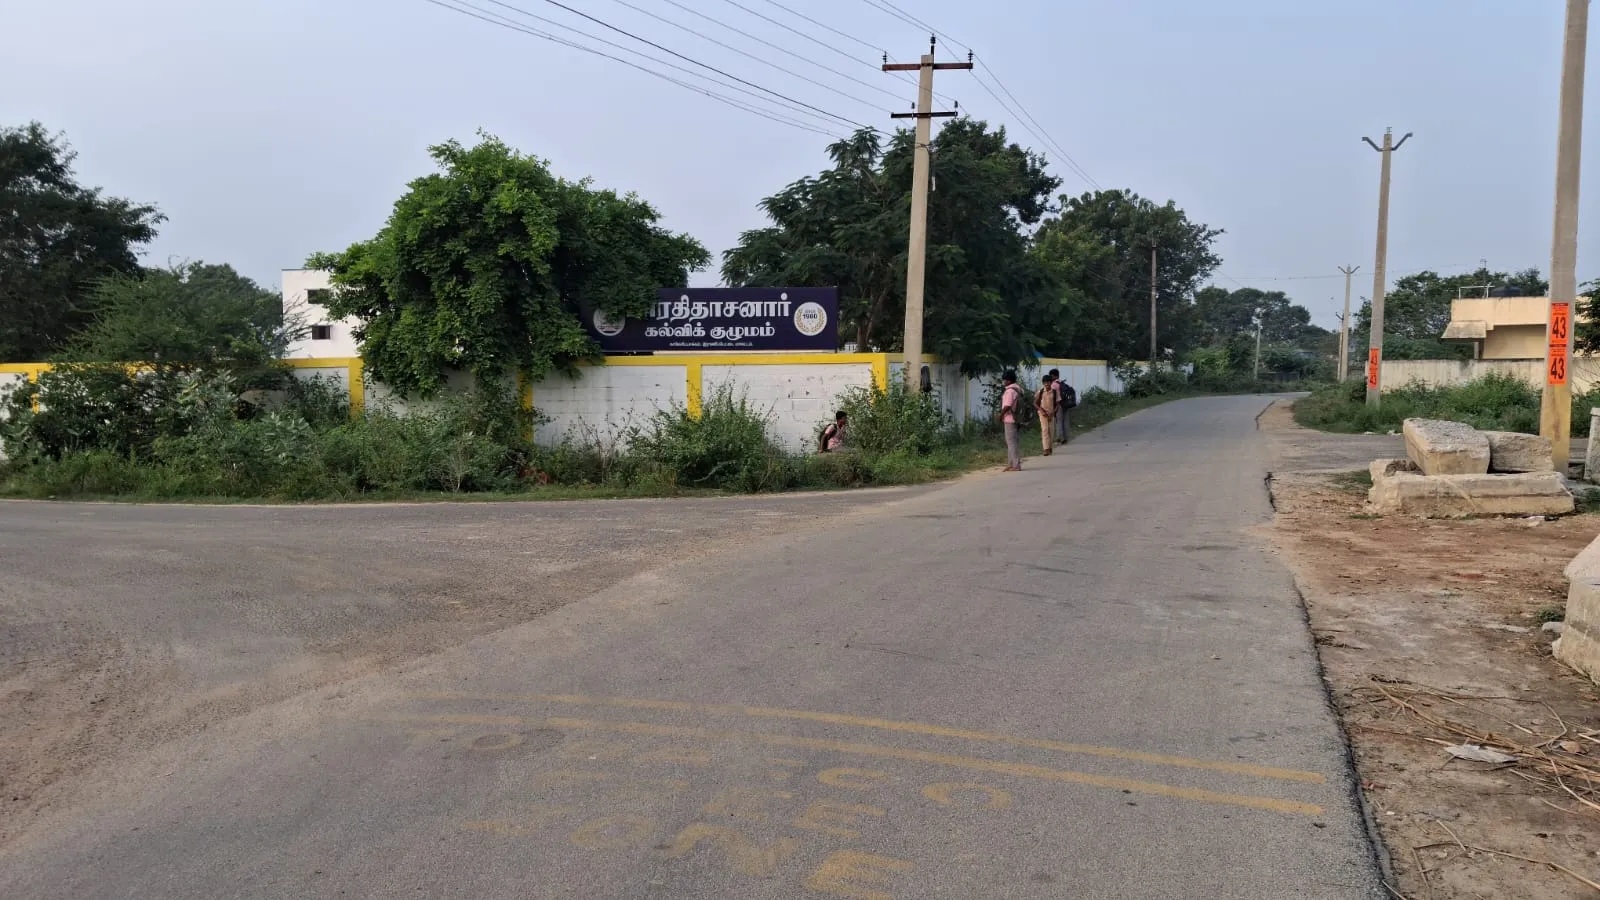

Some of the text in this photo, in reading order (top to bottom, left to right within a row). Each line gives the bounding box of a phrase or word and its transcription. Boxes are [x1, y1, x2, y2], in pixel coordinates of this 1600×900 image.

[644, 321, 776, 340] கல்விக் குழுமம்
[1552, 316, 1566, 338] 43
[1550, 357, 1565, 380] 43
